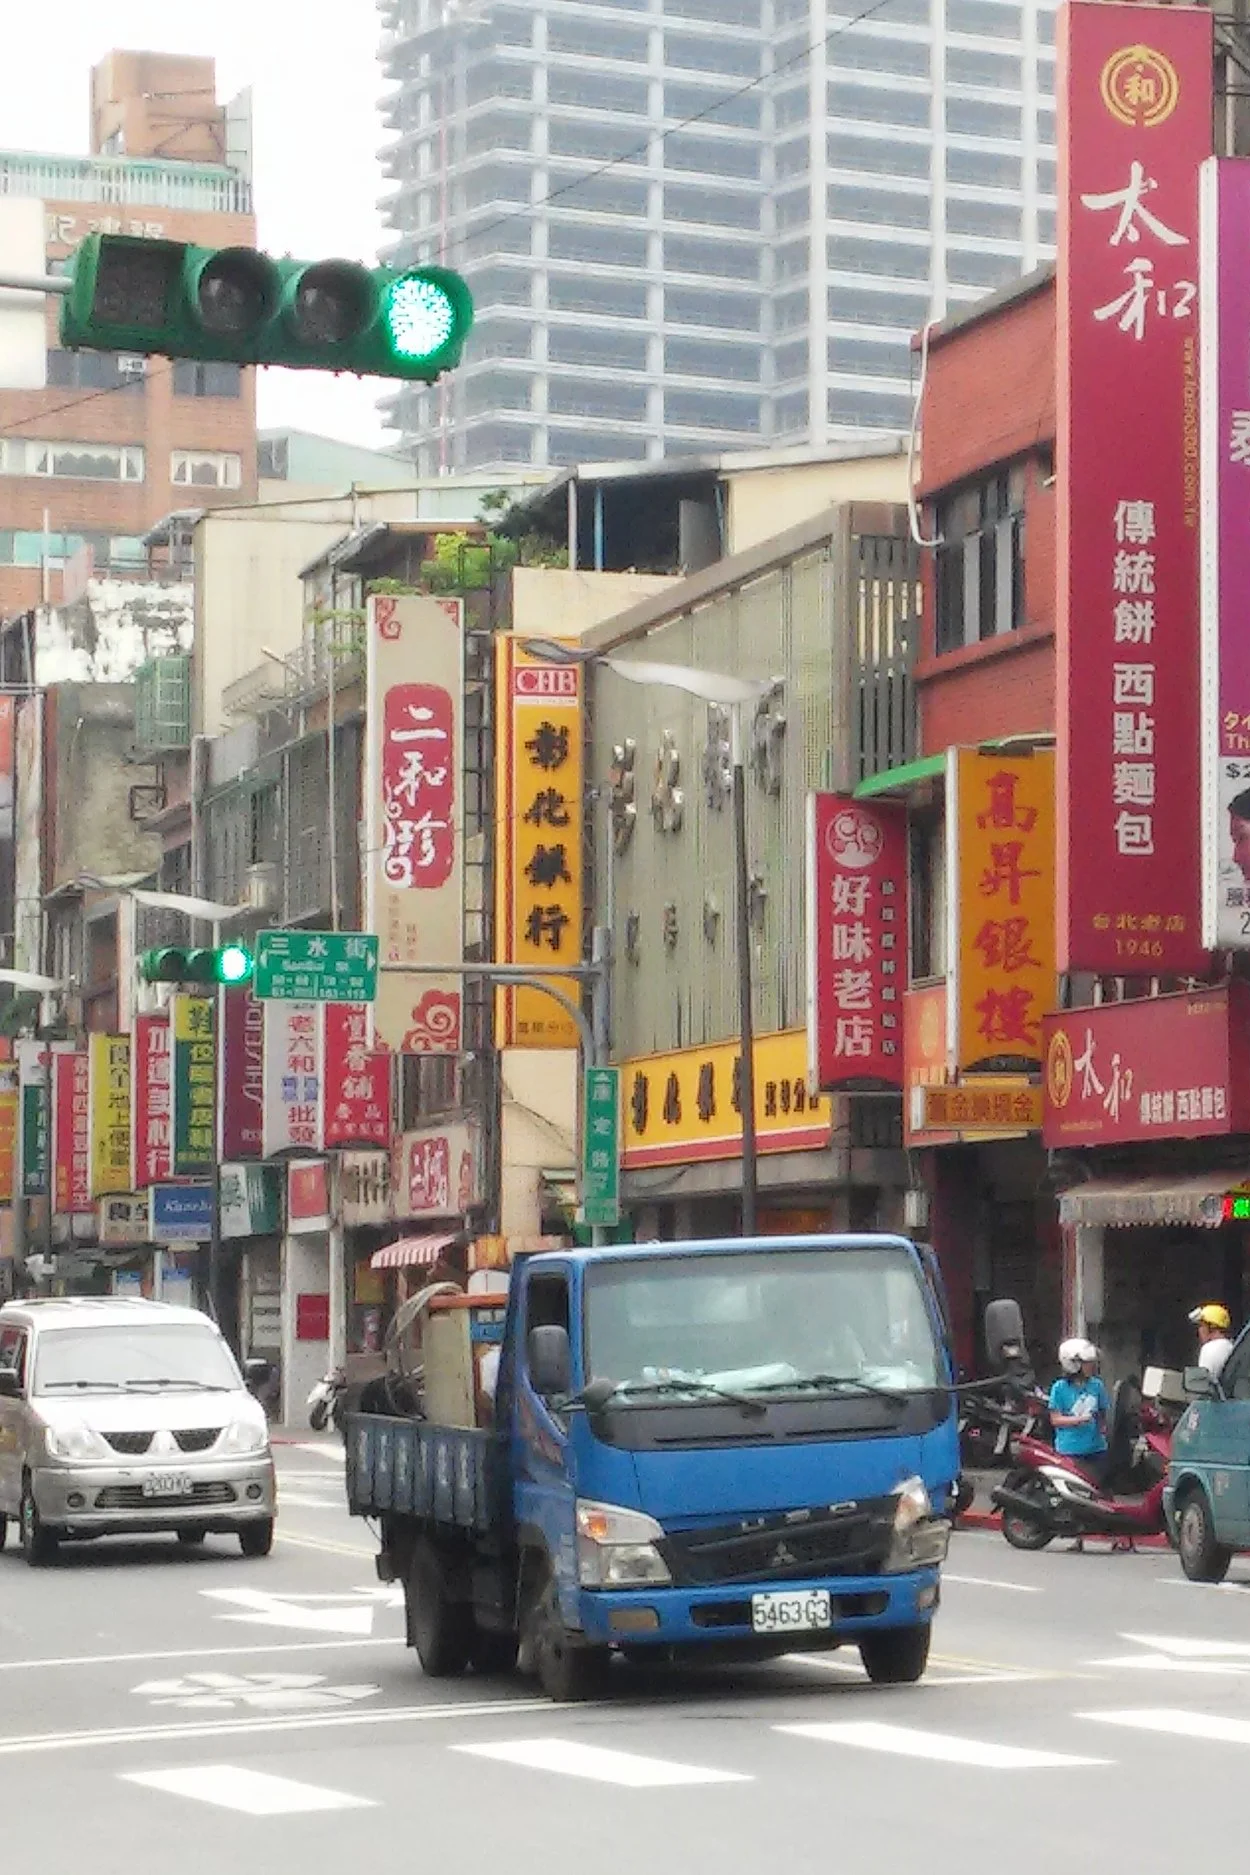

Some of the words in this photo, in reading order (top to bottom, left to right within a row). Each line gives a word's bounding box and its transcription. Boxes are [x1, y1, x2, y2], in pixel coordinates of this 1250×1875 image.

[1113, 499, 1156, 645] 傳統餅
[516, 669, 577, 694] CHB
[1113, 663, 1156, 856] 西點麵包
[268, 936, 369, 959] 三水街
[831, 874, 873, 1056] 好味老店
[974, 771, 1042, 1047] 高昇銀樓
